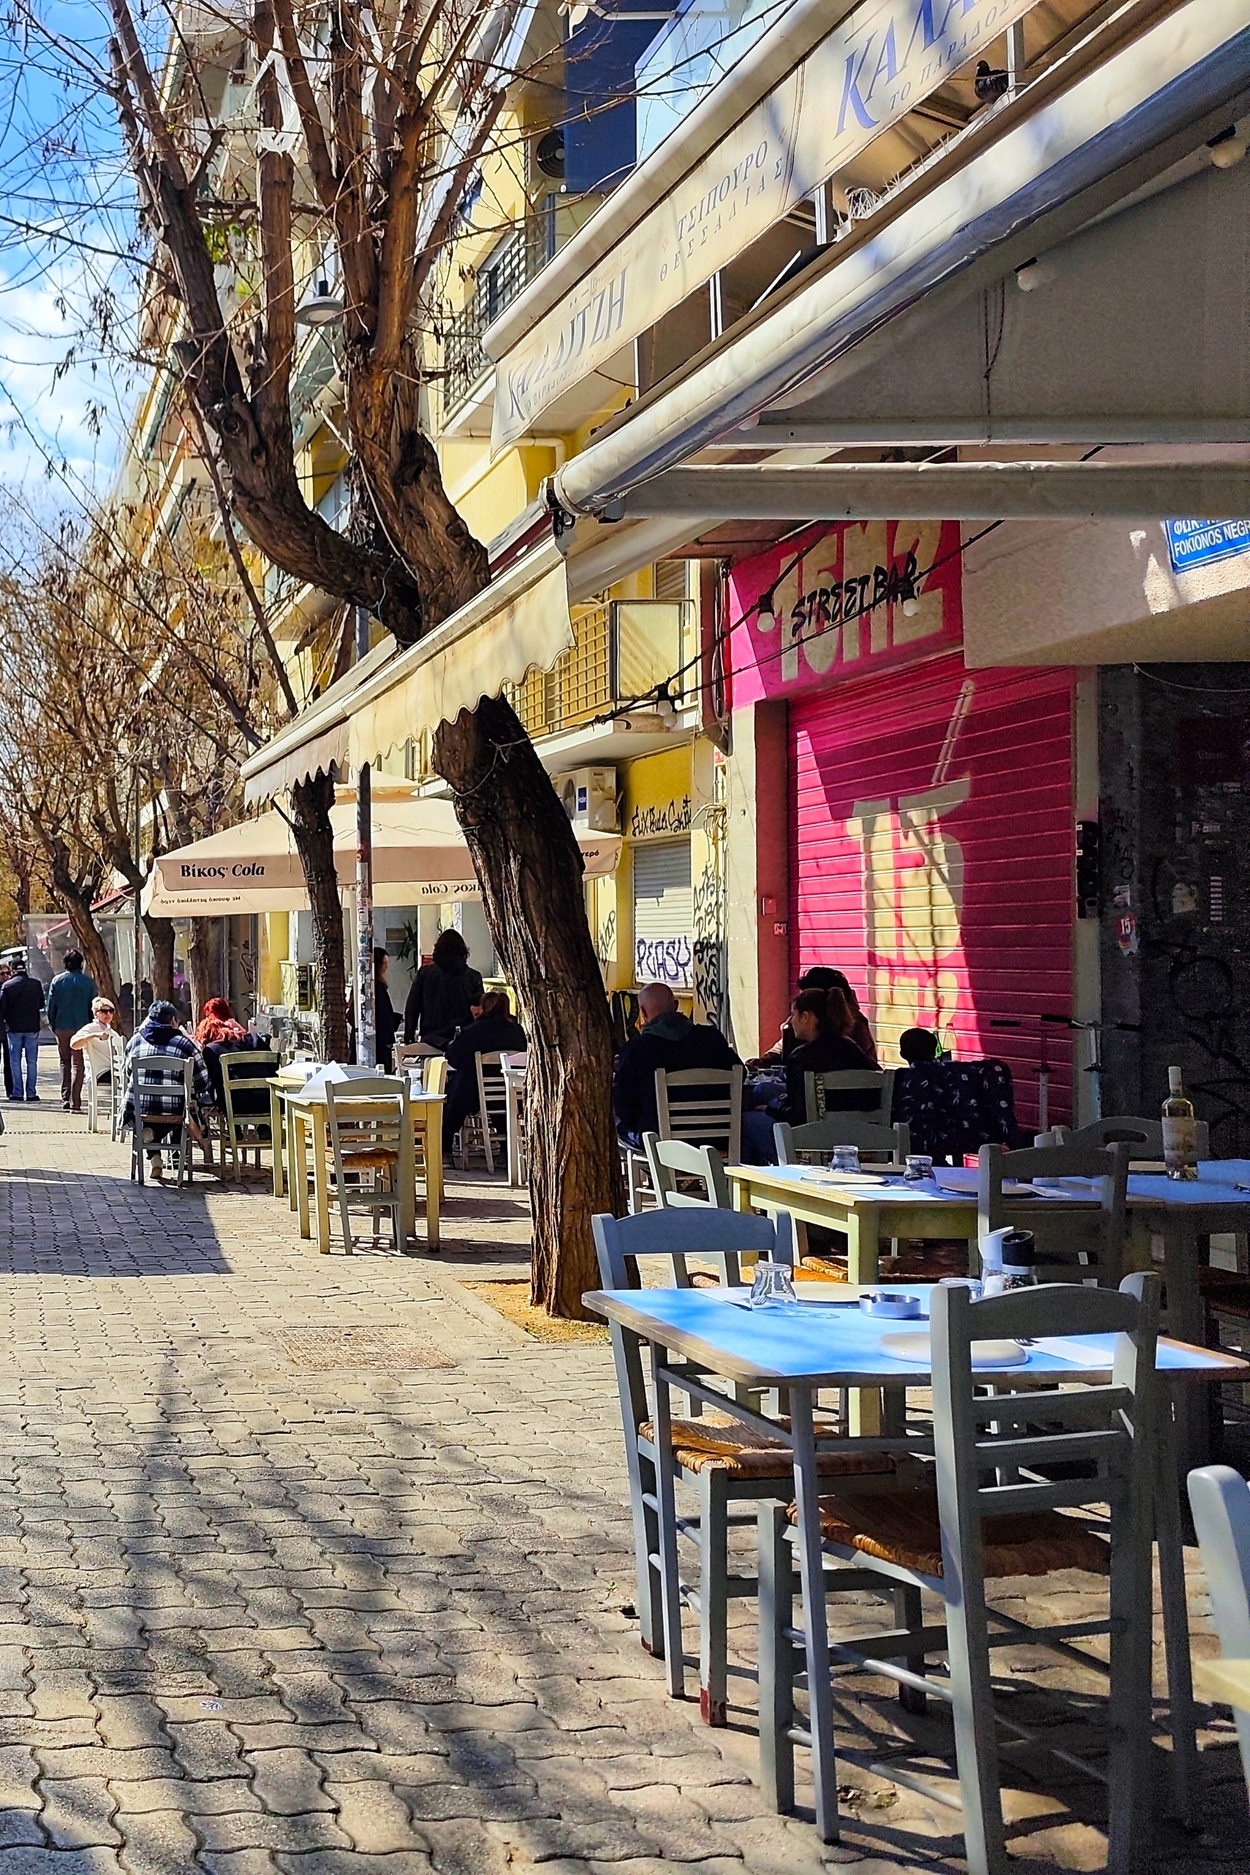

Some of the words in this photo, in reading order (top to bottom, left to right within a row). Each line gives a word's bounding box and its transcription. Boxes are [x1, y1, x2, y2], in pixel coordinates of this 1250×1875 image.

[834, 0, 982, 139] ΚΑΛ
[919, 0, 1017, 86] ΠΑΡΑΔΟΣ
[659, 156, 784, 283] ΘΕΣΣΑΛΙΑΣ
[677, 140, 769, 242] ΤΣΙΠΟΥΡΟ
[1174, 529, 1222, 557] FOKIONOS
[791, 574, 871, 638] STREET
[232, 862, 266, 877] Cola
